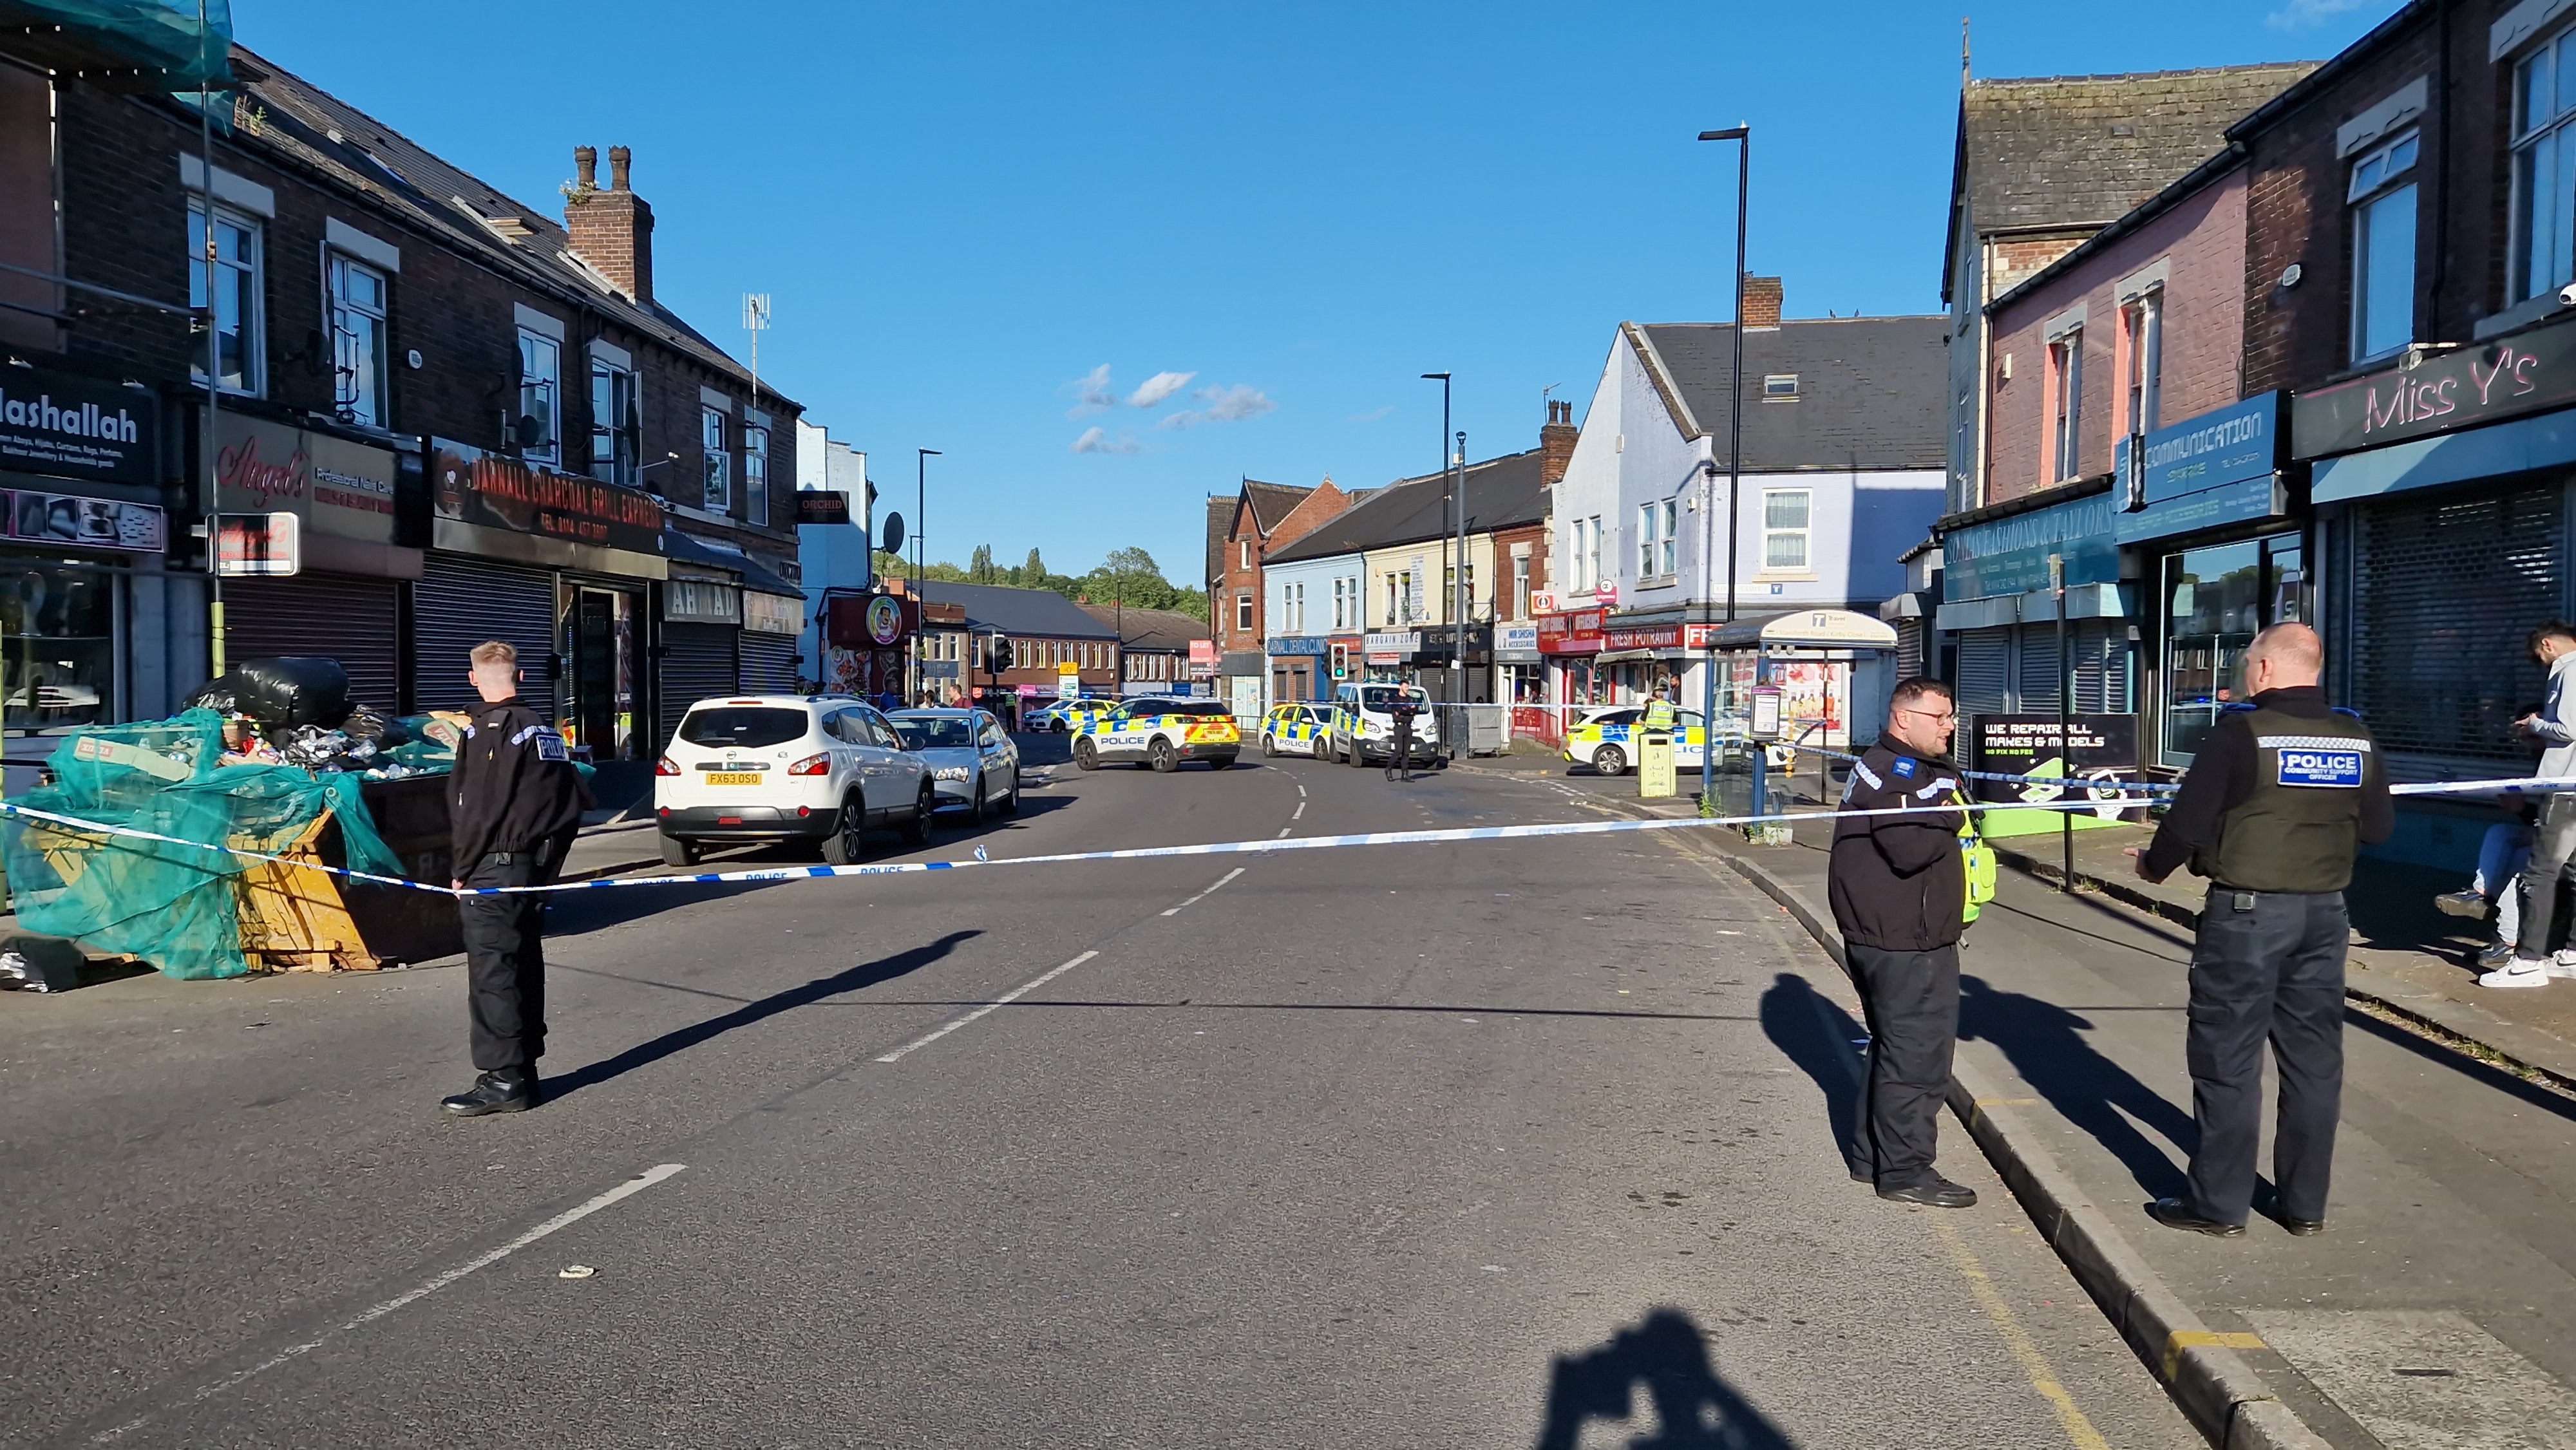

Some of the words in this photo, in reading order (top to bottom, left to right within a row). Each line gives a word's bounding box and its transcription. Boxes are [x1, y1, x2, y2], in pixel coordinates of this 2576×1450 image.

[2364, 377, 2457, 433] Miss
[2469, 348, 2537, 405] Y's
[0, 388, 137, 444] ashallah
[2145, 411, 2262, 469] COMMUNICATION
[471, 458, 529, 502] DARNALL
[532, 472, 589, 514] CHARCOAL
[802, 500, 843, 510] ORCHID
[2053, 500, 2113, 543] TAYLORS
[1366, 635, 1396, 645] BARGAIN
[1400, 634, 1419, 644] ZONE
[1517, 629, 1535, 639] SHISHA
[1611, 632, 1633, 647] FRESH
[1635, 630, 1677, 645] POTRAVINY
[1267, 639, 1289, 654] DARNALL
[1289, 639, 1308, 653] DENTAL
[1309, 638, 1328, 653] CLINIC
[1985, 724, 2006, 734] WE
[2010, 724, 2061, 734] REPAIR
[2067, 724, 2092, 734] ALL
[1279, 739, 1310, 748] POLICE
[1985, 737, 2032, 747] MAKES
[2034, 737, 2046, 747] &
[2287, 754, 2357, 769] POLICE
[710, 774, 736, 784] FX63
